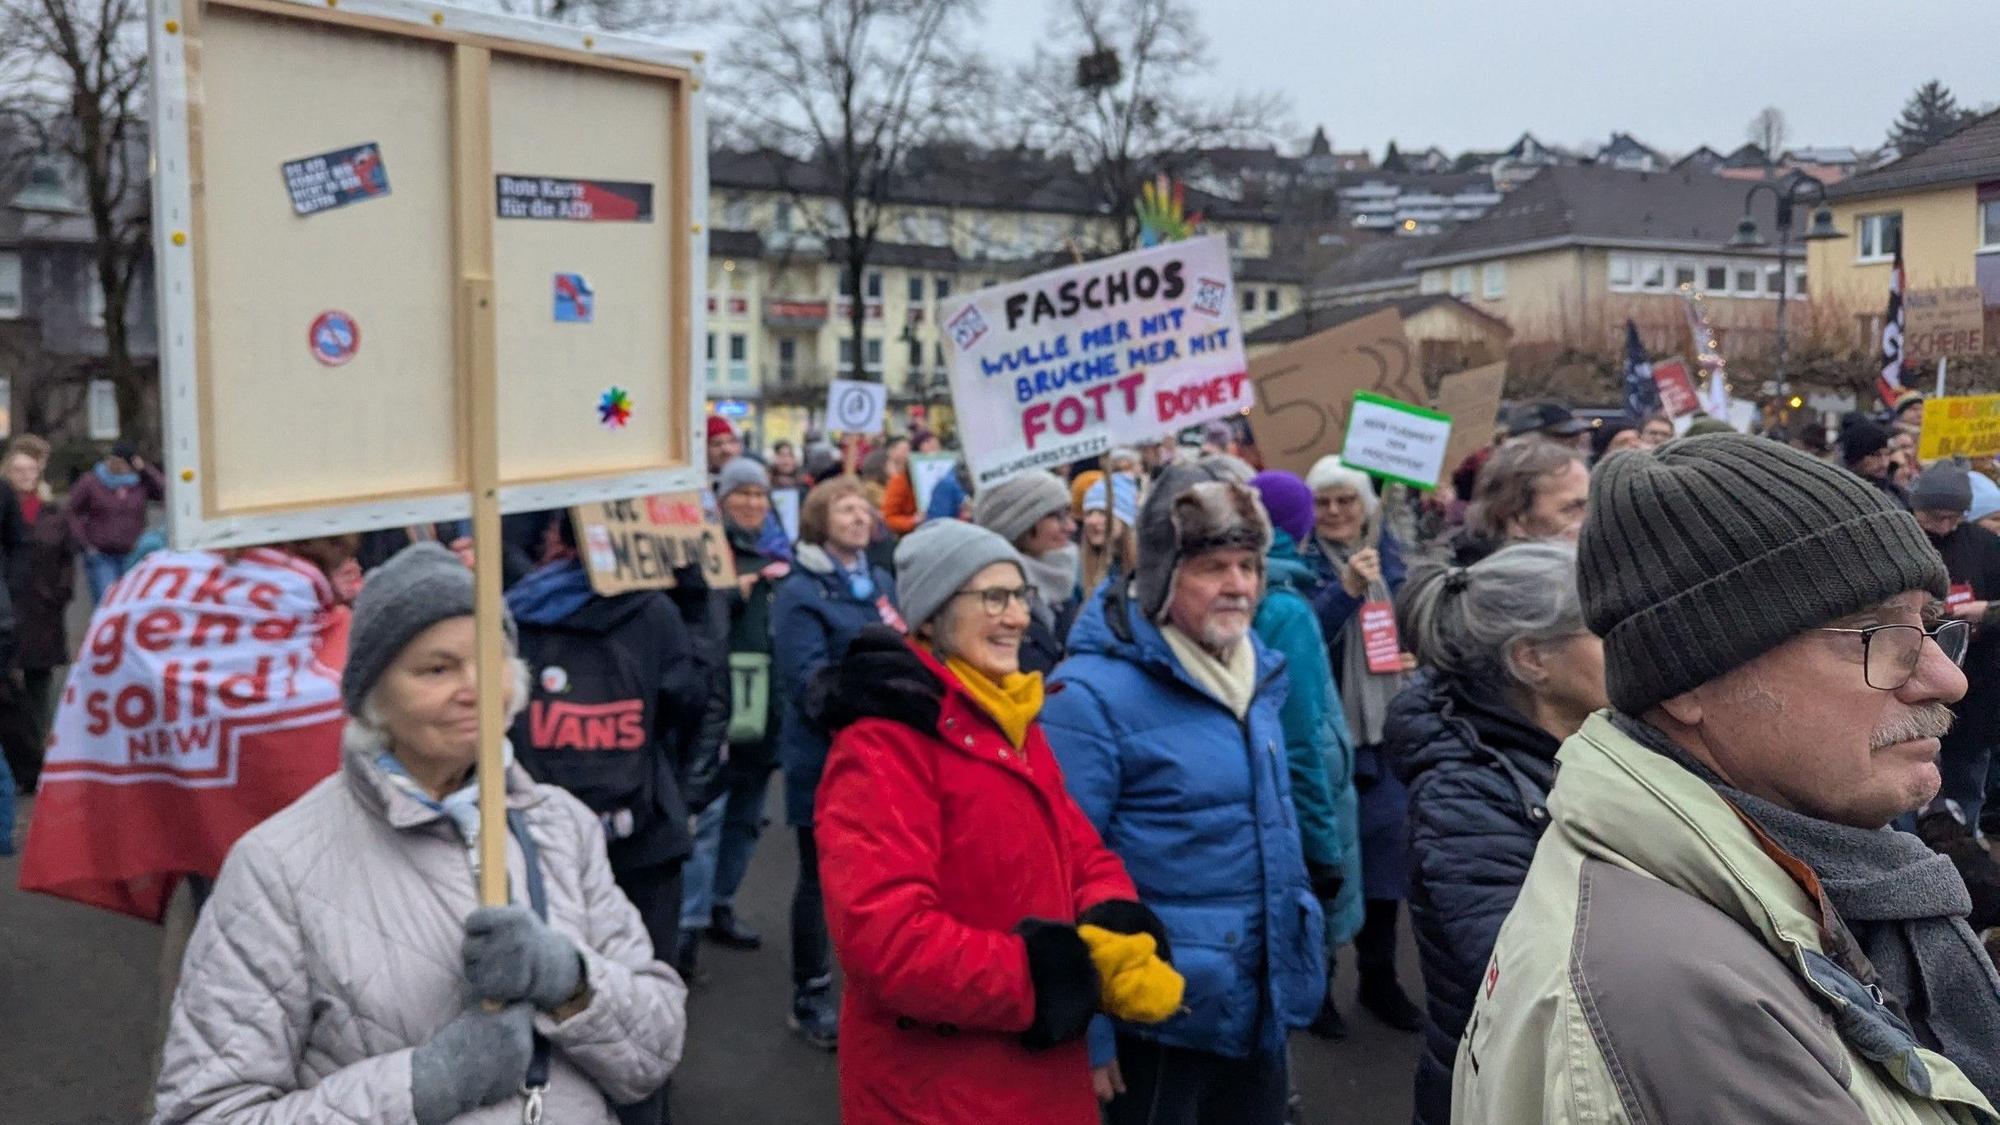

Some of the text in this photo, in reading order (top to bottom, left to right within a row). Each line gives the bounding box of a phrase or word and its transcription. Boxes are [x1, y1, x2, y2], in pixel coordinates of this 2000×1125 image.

[500, 176, 586, 199] Rote Karte
[500, 197, 528, 217] für
[530, 199, 556, 217] die
[1005, 260, 1185, 331] FASCHOS
[980, 334, 1070, 377] WULLE
[1081, 319, 1131, 350] MER
[1015, 353, 1120, 404] BRUCHE
[1128, 339, 1181, 368] MER
[1021, 372, 1248, 450] FOTT DOMET
[1258, 363, 1327, 455] 5
[127, 720, 213, 763] NRW
[529, 699, 646, 750] VANS
